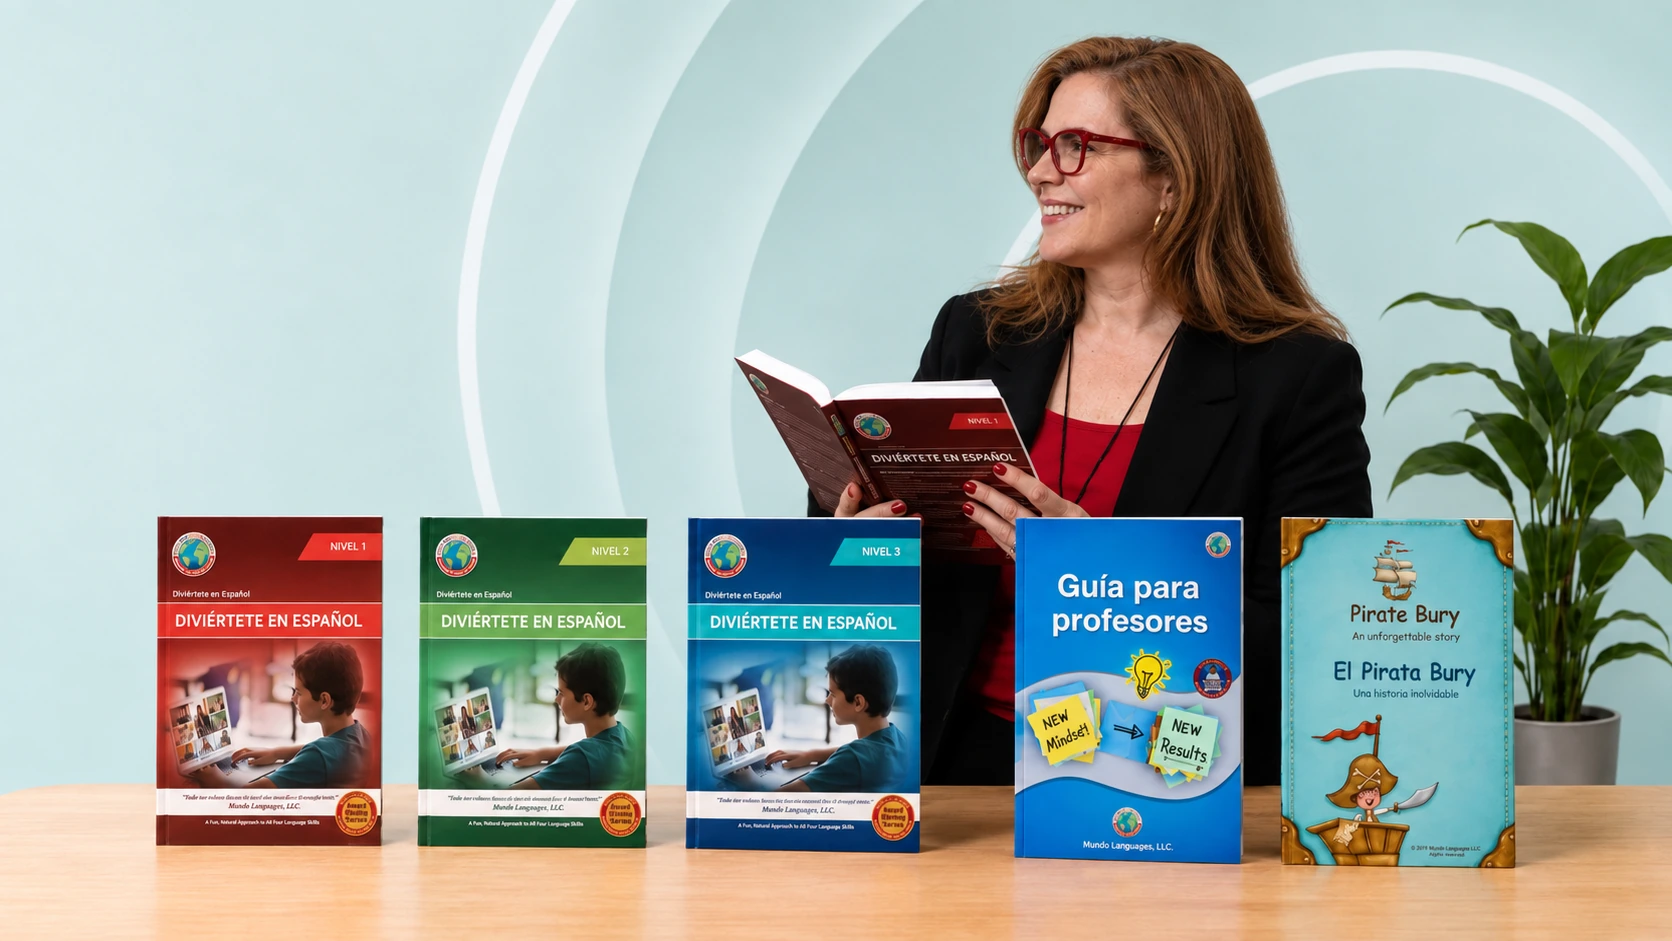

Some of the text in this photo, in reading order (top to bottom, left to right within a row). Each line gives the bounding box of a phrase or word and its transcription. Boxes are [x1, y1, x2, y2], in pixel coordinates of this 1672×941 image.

[871, 452, 1016, 462] DIVIÉRTETE EN ESPAÑOL
[330, 542, 358, 550] NIVEL
[592, 547, 629, 556] NIVEL 2
[862, 547, 900, 556] NIVEL 3
[1058, 573, 1199, 604] Guía para
[222, 590, 250, 599] Español
[484, 591, 512, 599] Español
[754, 592, 782, 600] Español
[176, 610, 362, 627] DIVIÉRTETE EN ESPAÑOL
[442, 611, 626, 628] DIVIÉRTETE EN ESPAÑOL
[710, 612, 897, 630] DIVIÉRTETE EN ESPAÑOL
[1351, 604, 1460, 629] Pirate Bury
[1053, 608, 1208, 637] profesores
[1352, 632, 1460, 643] An unforgettable story
[1334, 661, 1476, 686] El Pirata Bury
[1354, 689, 1459, 698] Una historia inolvidable
[1042, 709, 1069, 730] NEW
[1172, 718, 1202, 736] NEW
[1083, 840, 1174, 851] Mundo Languages, LLC.
